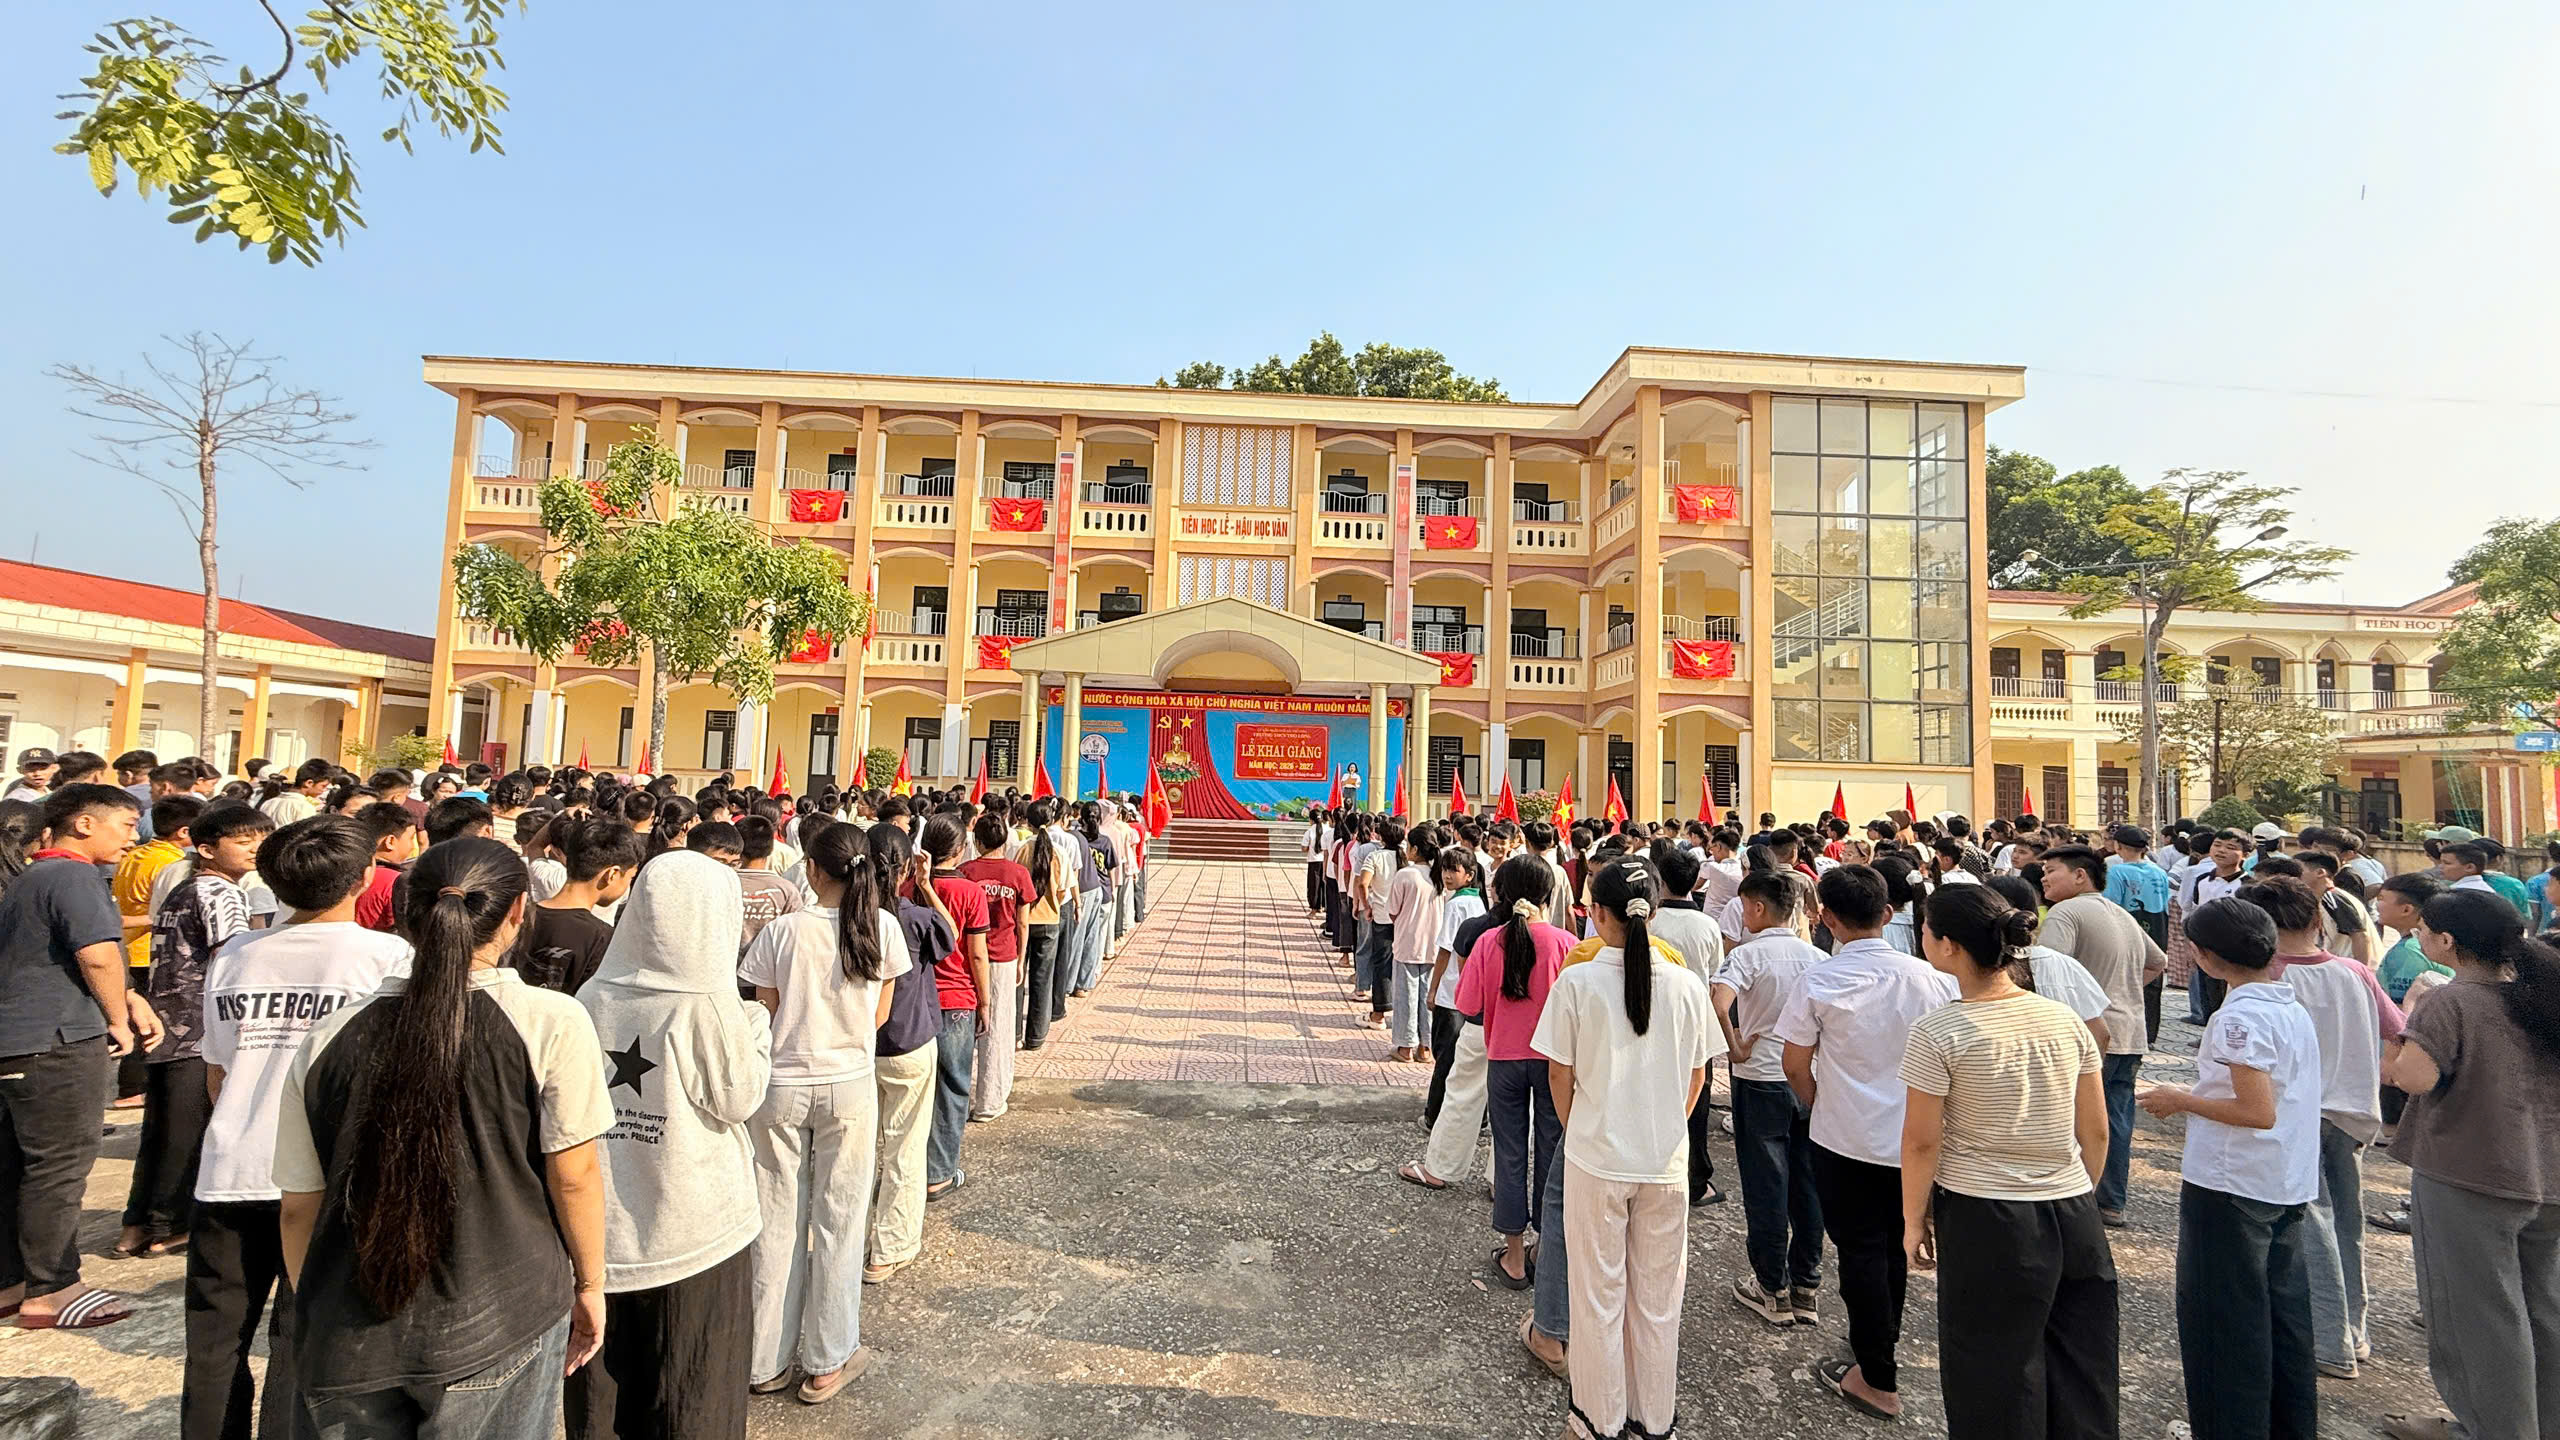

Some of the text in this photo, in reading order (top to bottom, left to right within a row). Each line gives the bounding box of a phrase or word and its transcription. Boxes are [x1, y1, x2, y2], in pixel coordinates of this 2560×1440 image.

[1201, 518, 1217, 538] HỌC
[1254, 520, 1270, 540] HỌC
[1084, 693, 1113, 704] NƯỚC
[1115, 694, 1143, 706] CỘNG
[1186, 695, 1204, 708] HỘI
[1206, 695, 1227, 708] CHỦ
[1263, 699, 1285, 711] VIỆT
[1287, 702, 1311, 712] NAM
[1241, 738, 1322, 759] LỄ KHAI GIẢNG
[625, 1108, 637, 1117] the
